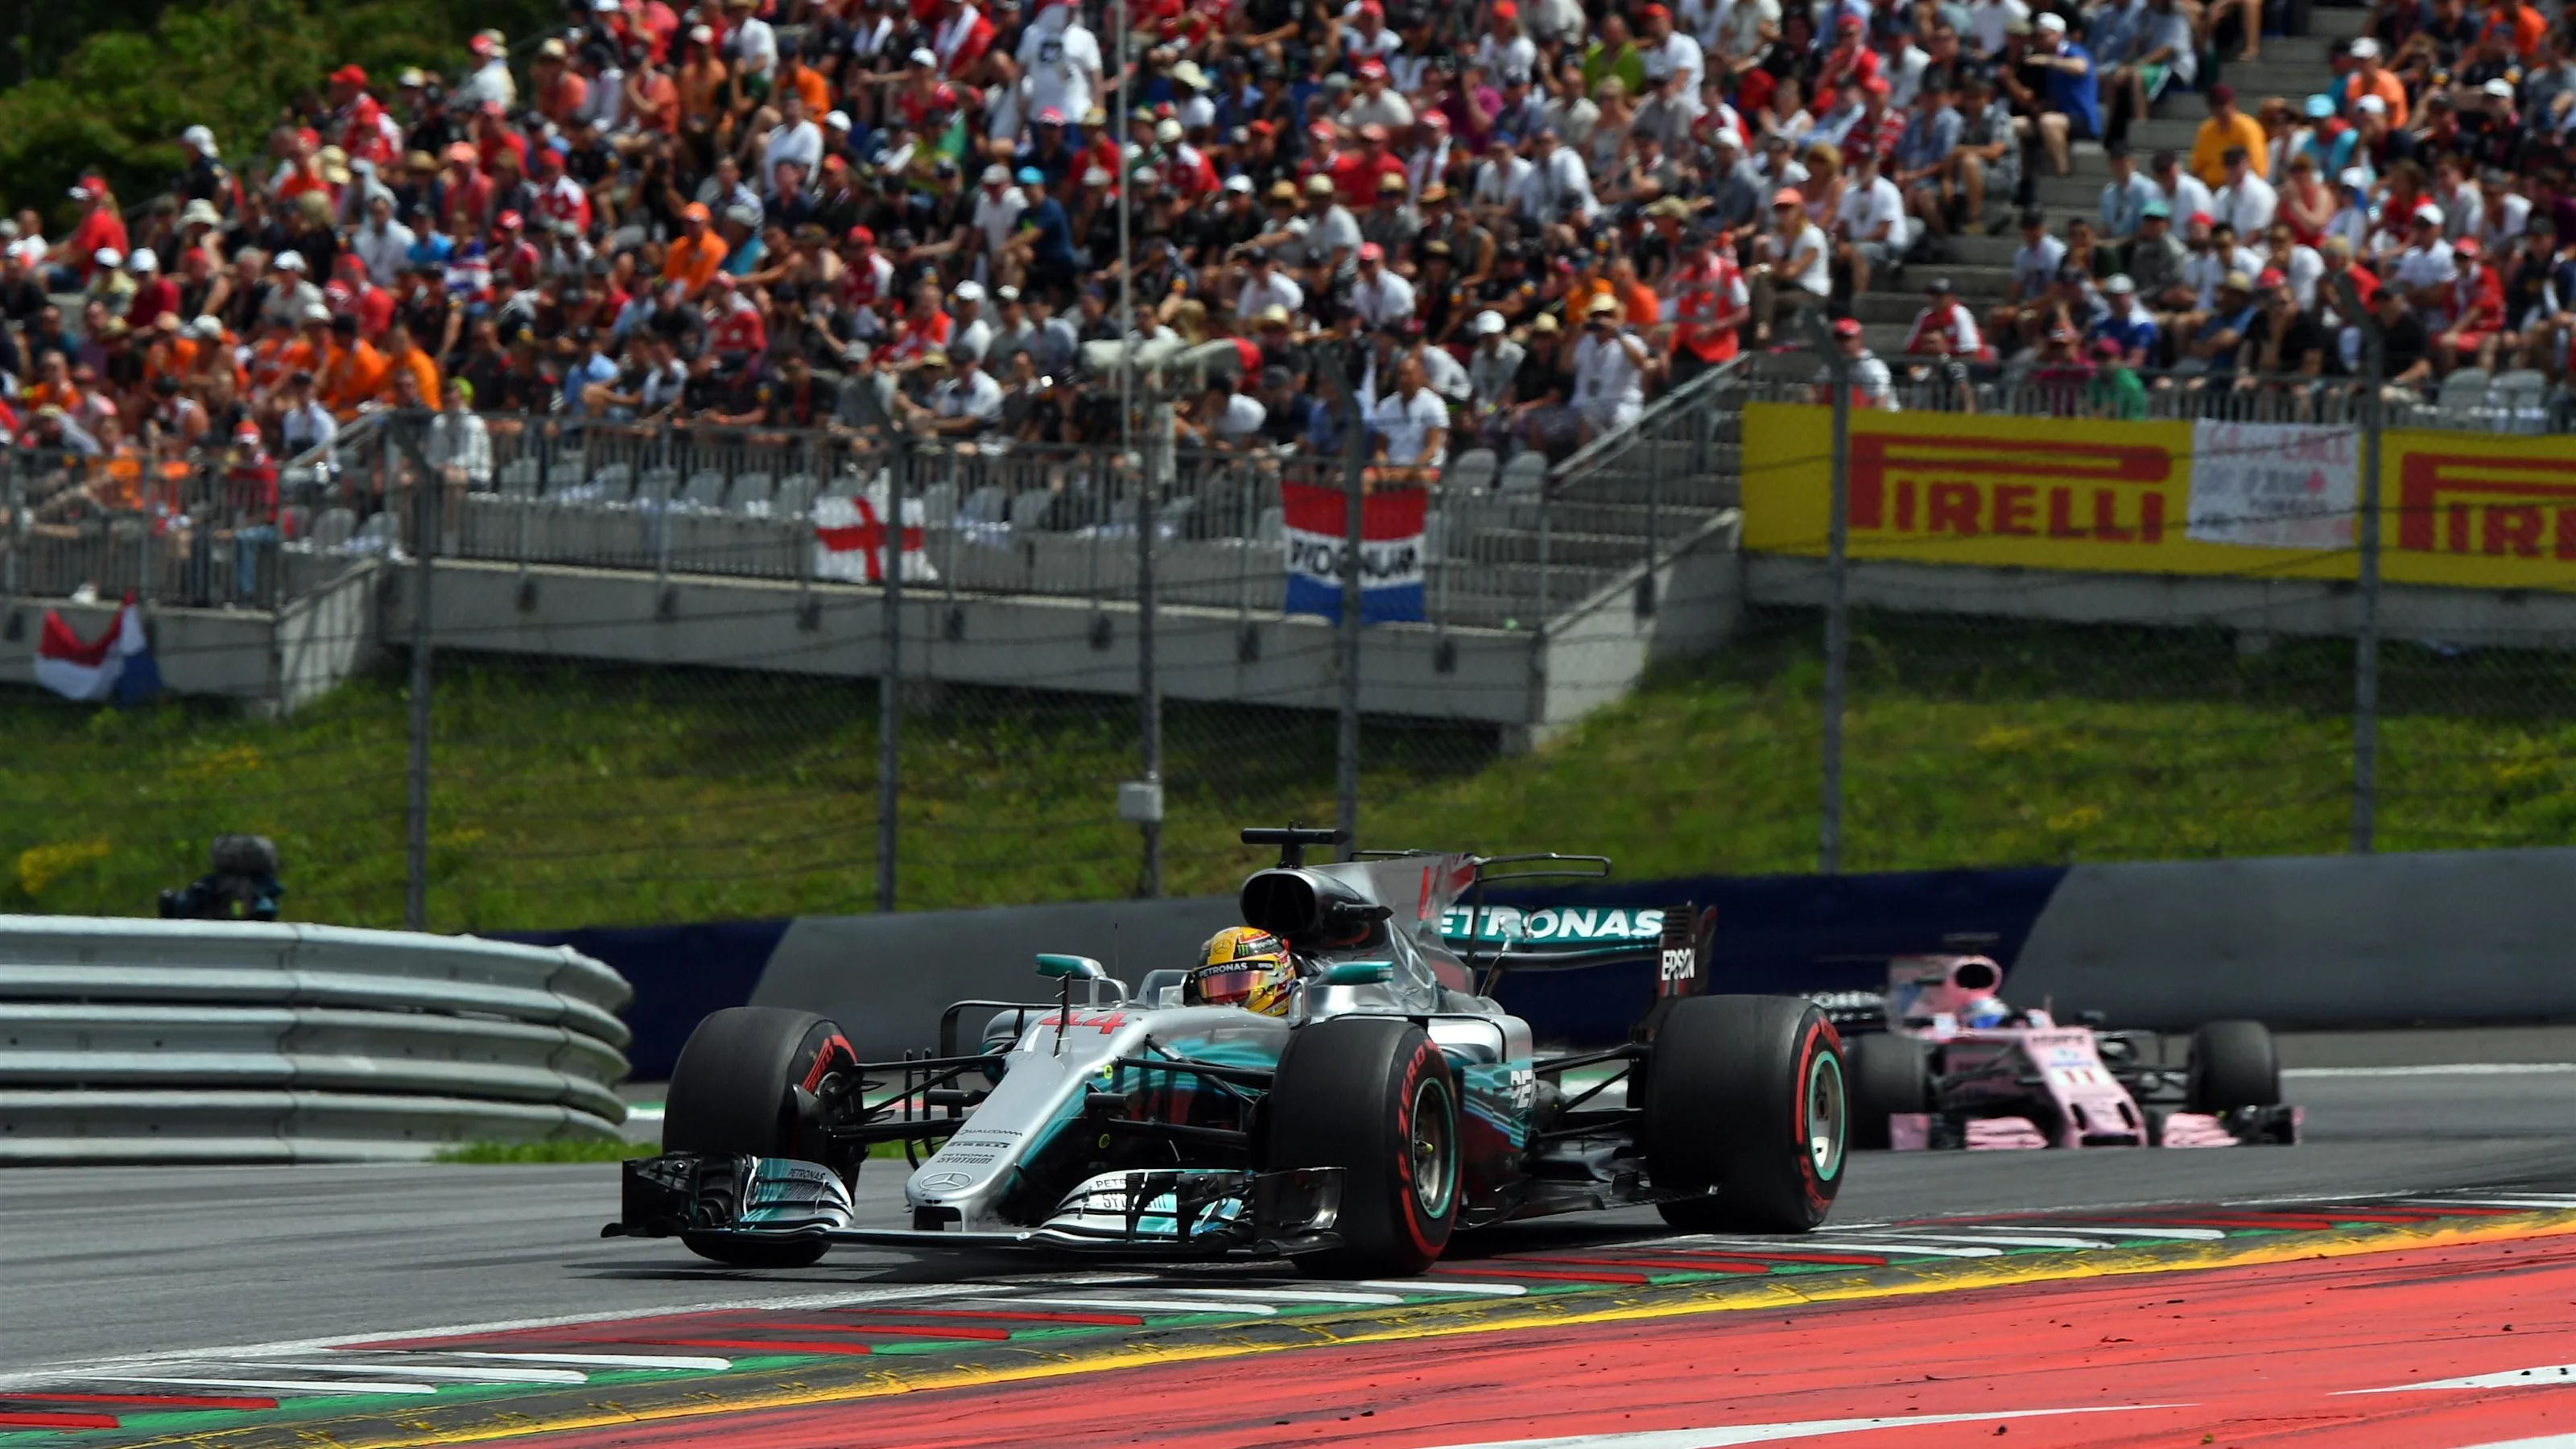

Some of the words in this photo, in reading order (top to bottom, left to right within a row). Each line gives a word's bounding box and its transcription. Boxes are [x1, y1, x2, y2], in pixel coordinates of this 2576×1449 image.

[1846, 431, 2171, 544] PIRELLI
[1440, 906, 1666, 939] ETRONAS
[1198, 963, 1248, 977] PETRONAS
[1662, 949, 1695, 981] EPSON
[1038, 1011, 1127, 1034] 44
[937, 1157, 993, 1165] SYNTIUM
[786, 1167, 826, 1181] PETRONAS
